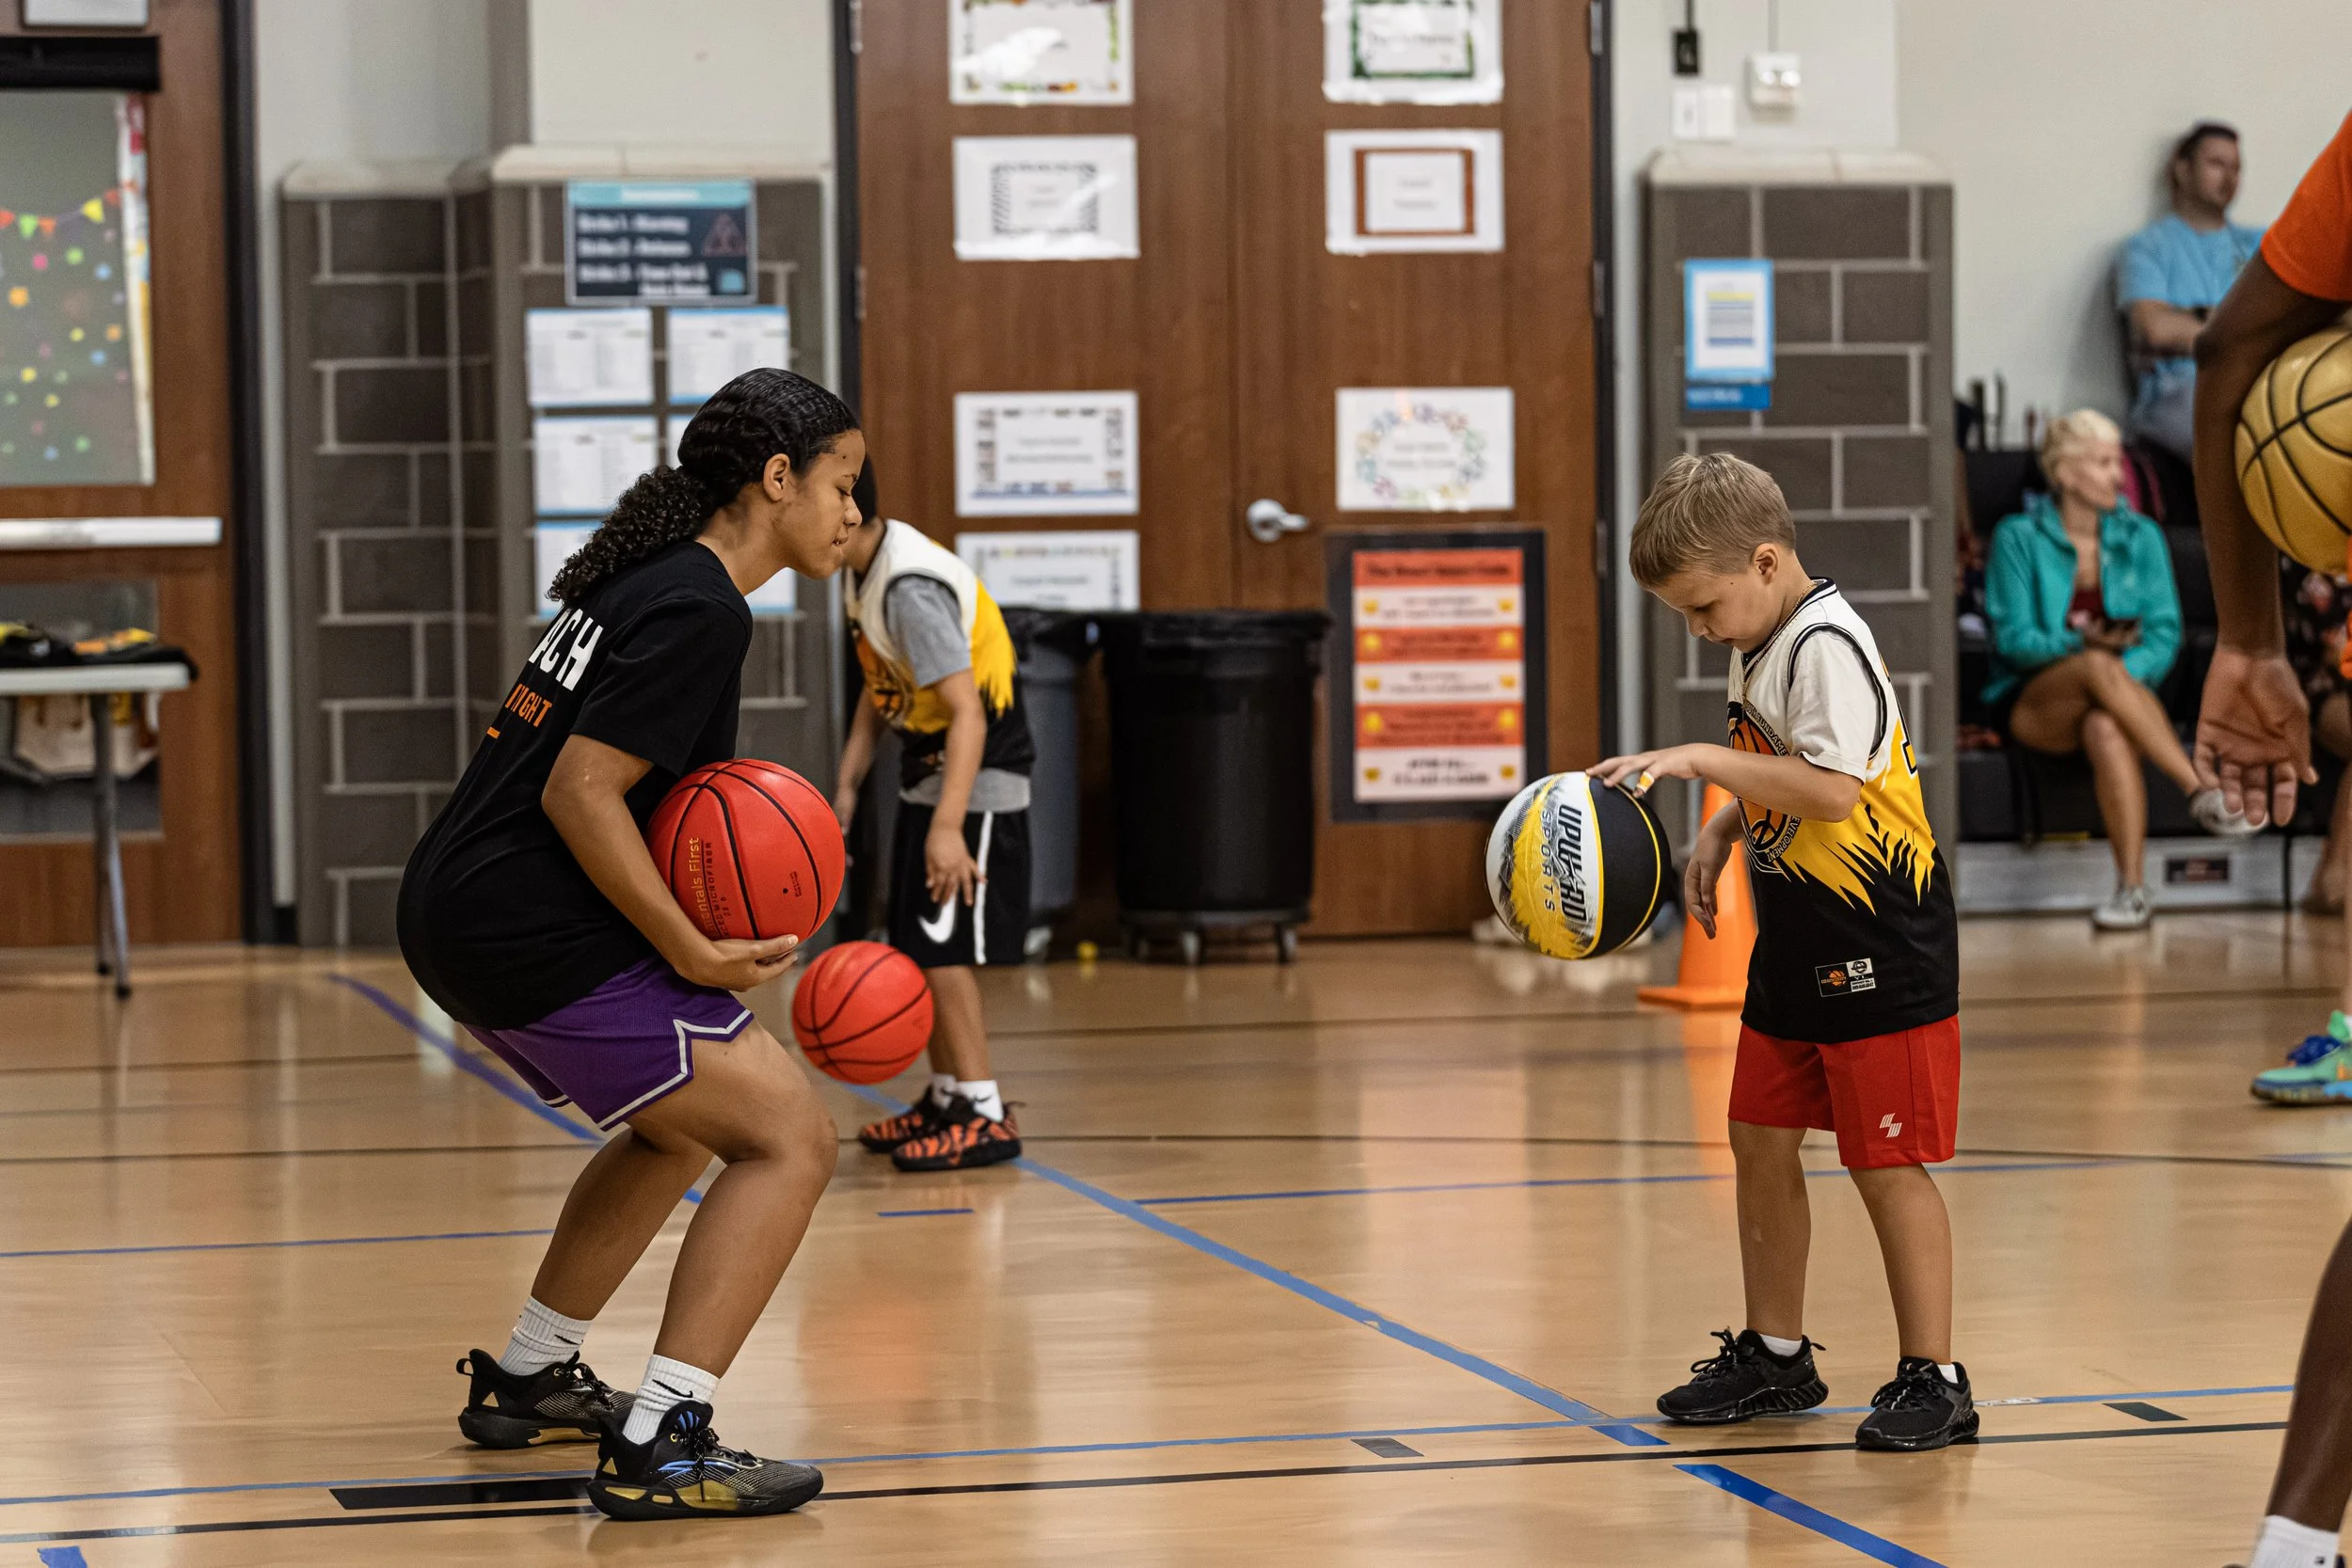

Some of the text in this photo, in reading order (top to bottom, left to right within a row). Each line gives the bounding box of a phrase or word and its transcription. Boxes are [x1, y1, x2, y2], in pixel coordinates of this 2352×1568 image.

[529, 609, 604, 691] ACH
[689, 837, 700, 872] First
[1540, 809, 1555, 912] SPORTS
[1557, 803, 1588, 922] UPWARD
[1767, 816, 1801, 863] EVELOPMENT
